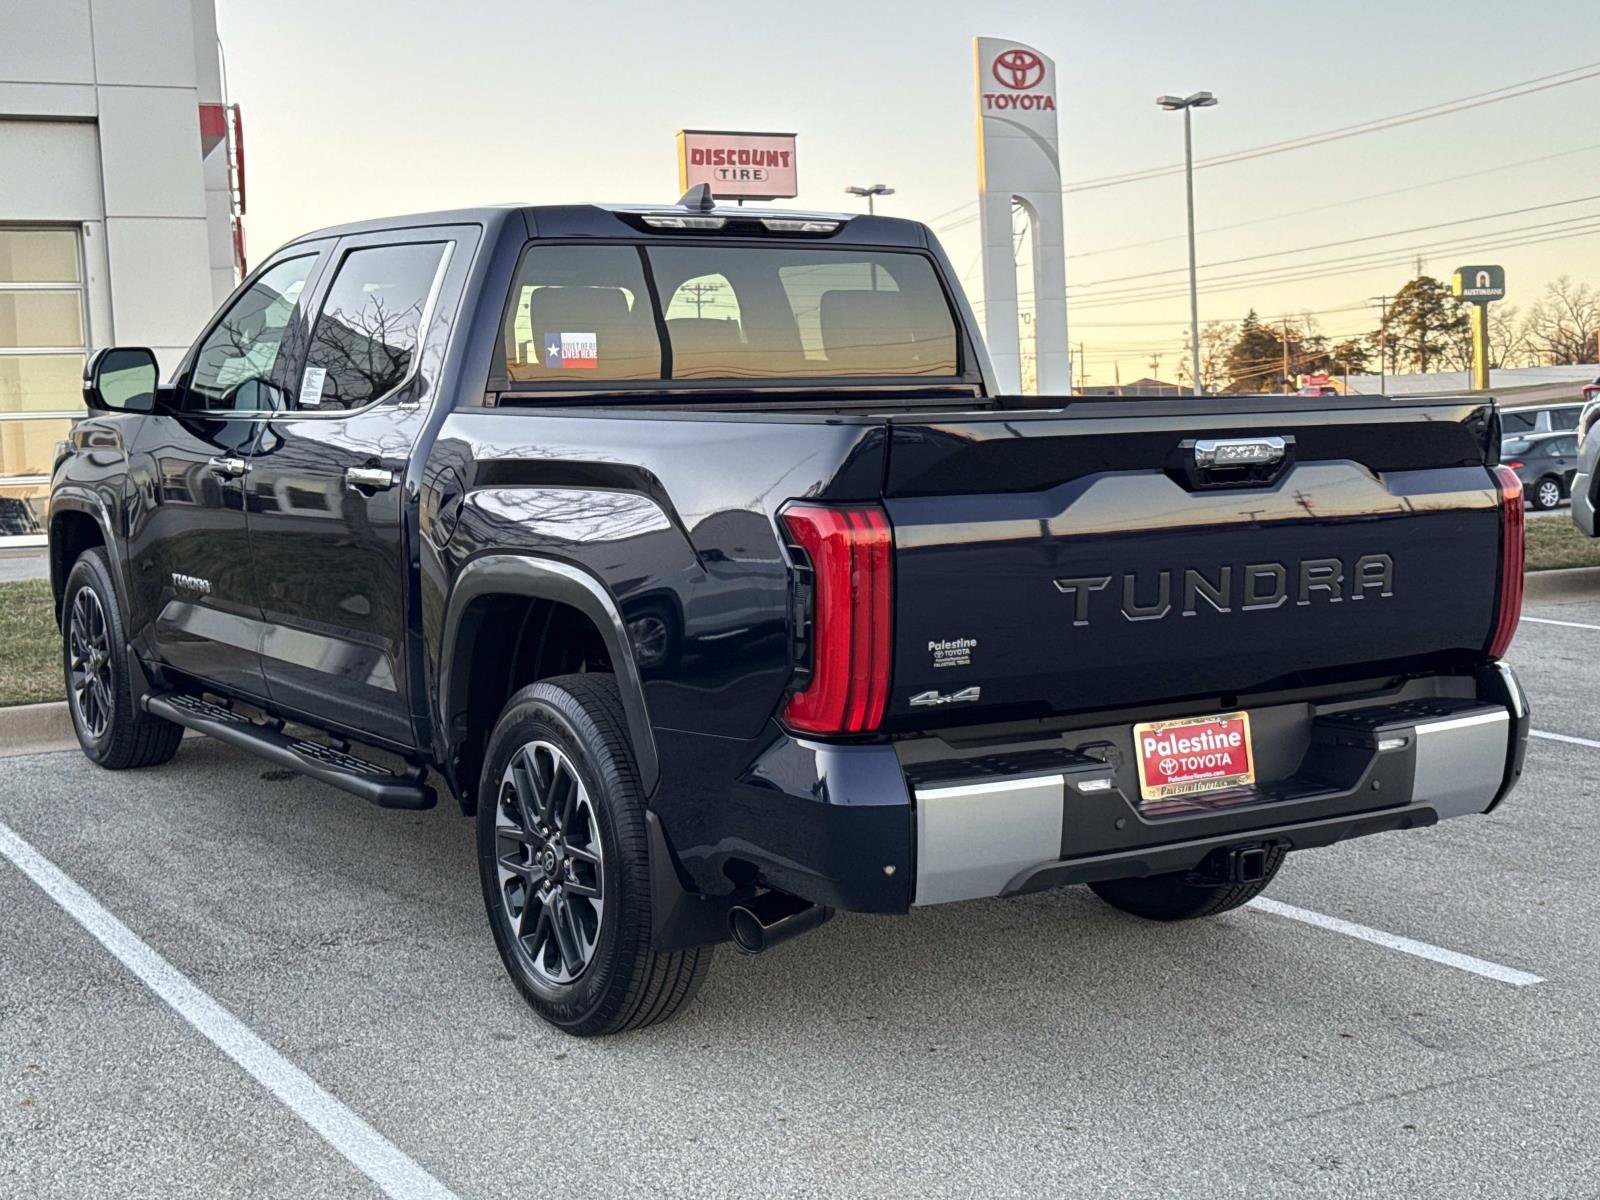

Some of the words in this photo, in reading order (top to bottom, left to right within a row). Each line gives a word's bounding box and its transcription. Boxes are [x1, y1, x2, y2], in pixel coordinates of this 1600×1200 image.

[983, 93, 1056, 110] TOYOTA
[691, 148, 790, 167] DISCOUNT
[719, 169, 763, 180] TIRE
[171, 572, 211, 593] TUNDRA
[1052, 553, 1394, 627] TUNDRA
[928, 638, 977, 651] Palestine
[945, 648, 970, 657] TOYOTA
[1143, 729, 1241, 758] Palestine
[1180, 752, 1232, 771] TOYOTA
